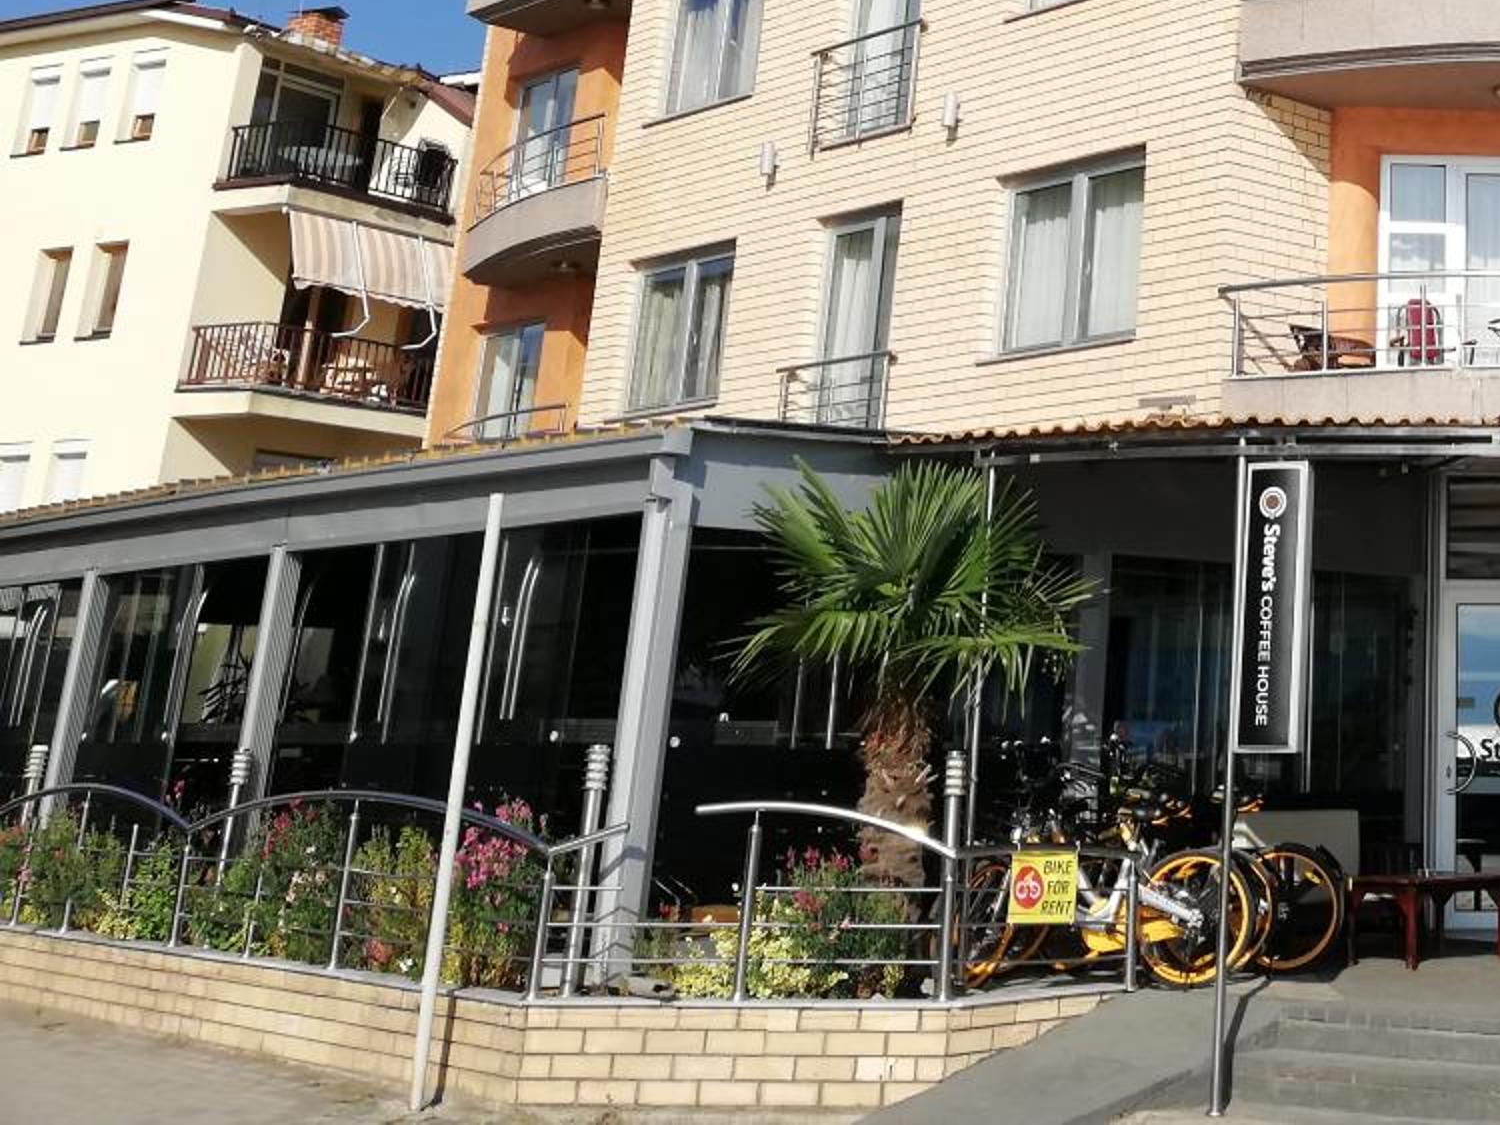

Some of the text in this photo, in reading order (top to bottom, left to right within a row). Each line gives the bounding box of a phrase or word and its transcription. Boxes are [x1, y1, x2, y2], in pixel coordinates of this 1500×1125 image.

[1255, 523, 1281, 727] Steve's COFFEE HOUSE
[1043, 860, 1074, 875] BIKE
[1047, 880, 1071, 895] FOR
[1041, 900, 1073, 915] RENT
